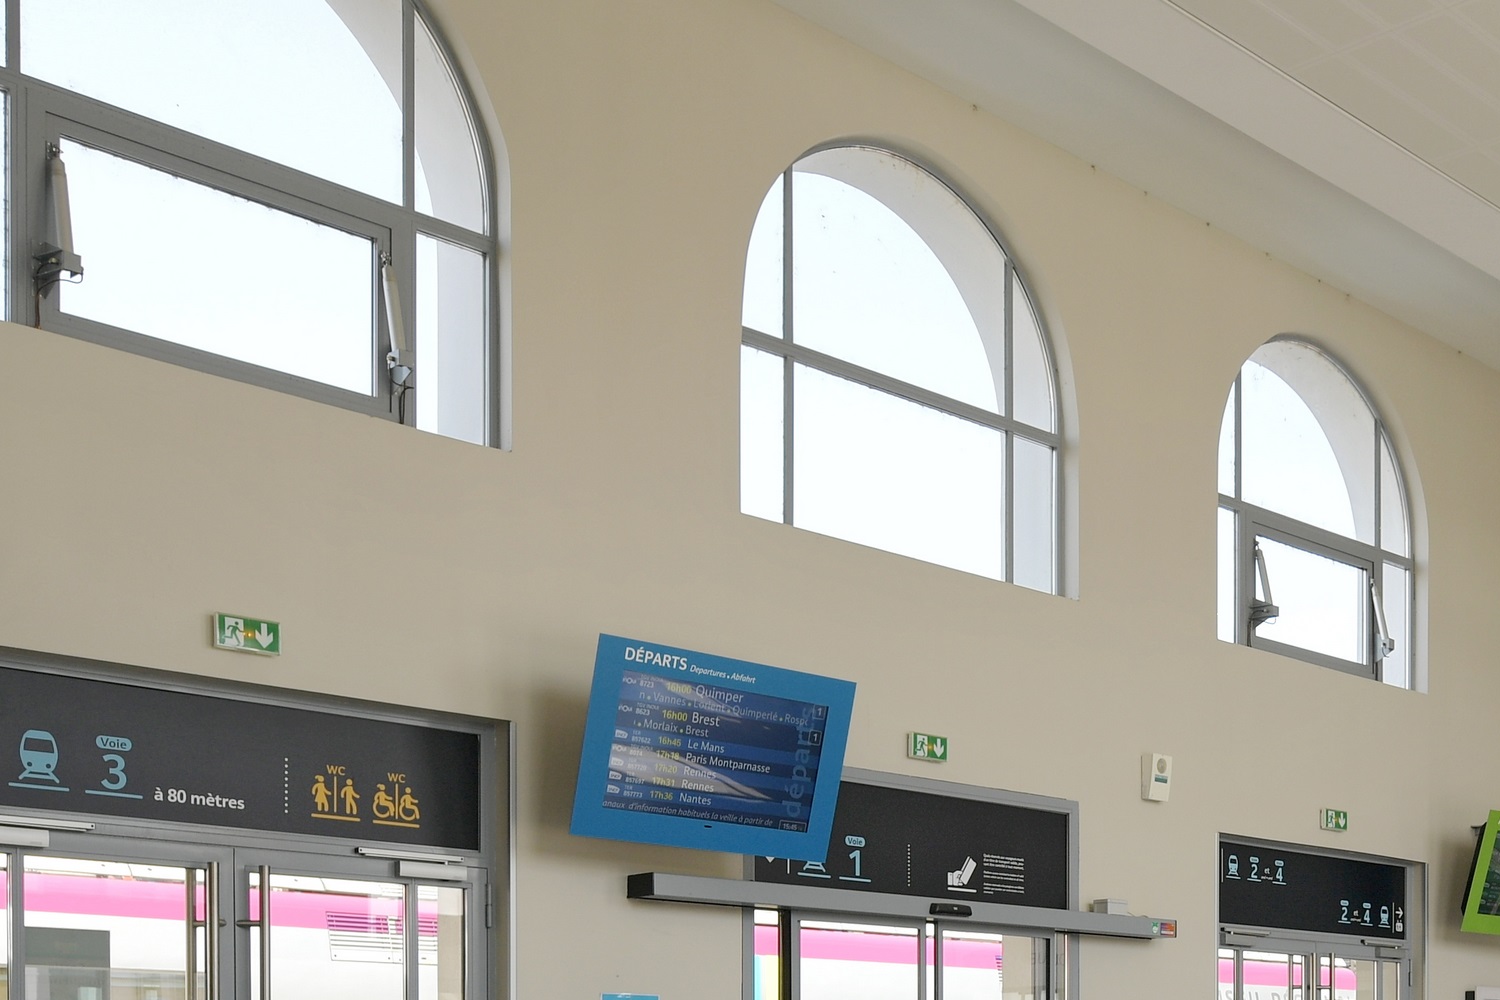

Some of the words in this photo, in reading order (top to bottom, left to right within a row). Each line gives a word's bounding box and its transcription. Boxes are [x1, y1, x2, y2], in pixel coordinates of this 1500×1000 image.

[624, 647, 688, 670] DÉPARTS
[690, 664, 726, 678] Departures
[730, 672, 756, 684] Abfahrt
[653, 692, 686, 706] Vannes
[693, 698, 725, 712] Lorient
[732, 705, 778, 721] Quimperlé
[696, 685, 744, 703] Quimper
[817, 708, 822, 716] 1
[643, 718, 678, 732] Morlaix
[686, 725, 708, 738] Brest
[662, 710, 688, 722] 16h00
[692, 712, 720, 727] Brest
[813, 734, 818, 742] 1
[100, 736, 127, 750] Voie
[658, 736, 682, 747] 16h45
[687, 739, 698, 750] Le
[700, 741, 724, 753] Mans
[326, 764, 346, 776] WC
[655, 763, 678, 772] 17h20
[684, 766, 716, 779] Rennes
[656, 750, 680, 760] 17h18
[686, 752, 706, 764] Paris
[708, 756, 771, 774] Montparnasse
[100, 754, 127, 790] 3
[387, 772, 406, 784] WC
[652, 776, 675, 786] 17h31
[681, 780, 714, 792] Rennes
[154, 786, 164, 802] à
[167, 788, 186, 804] 80
[190, 792, 245, 810] mètres
[650, 790, 674, 800] 17h36
[680, 793, 712, 806] Nantes
[628, 802, 677, 815] d'information
[765, 818, 773, 826] de
[847, 836, 863, 846] Voie
[849, 850, 860, 876] 1
[1251, 864, 1258, 878] 2
[1276, 868, 1283, 882] 4
[1342, 906, 1348, 920] 2
[1364, 910, 1370, 924] 4
